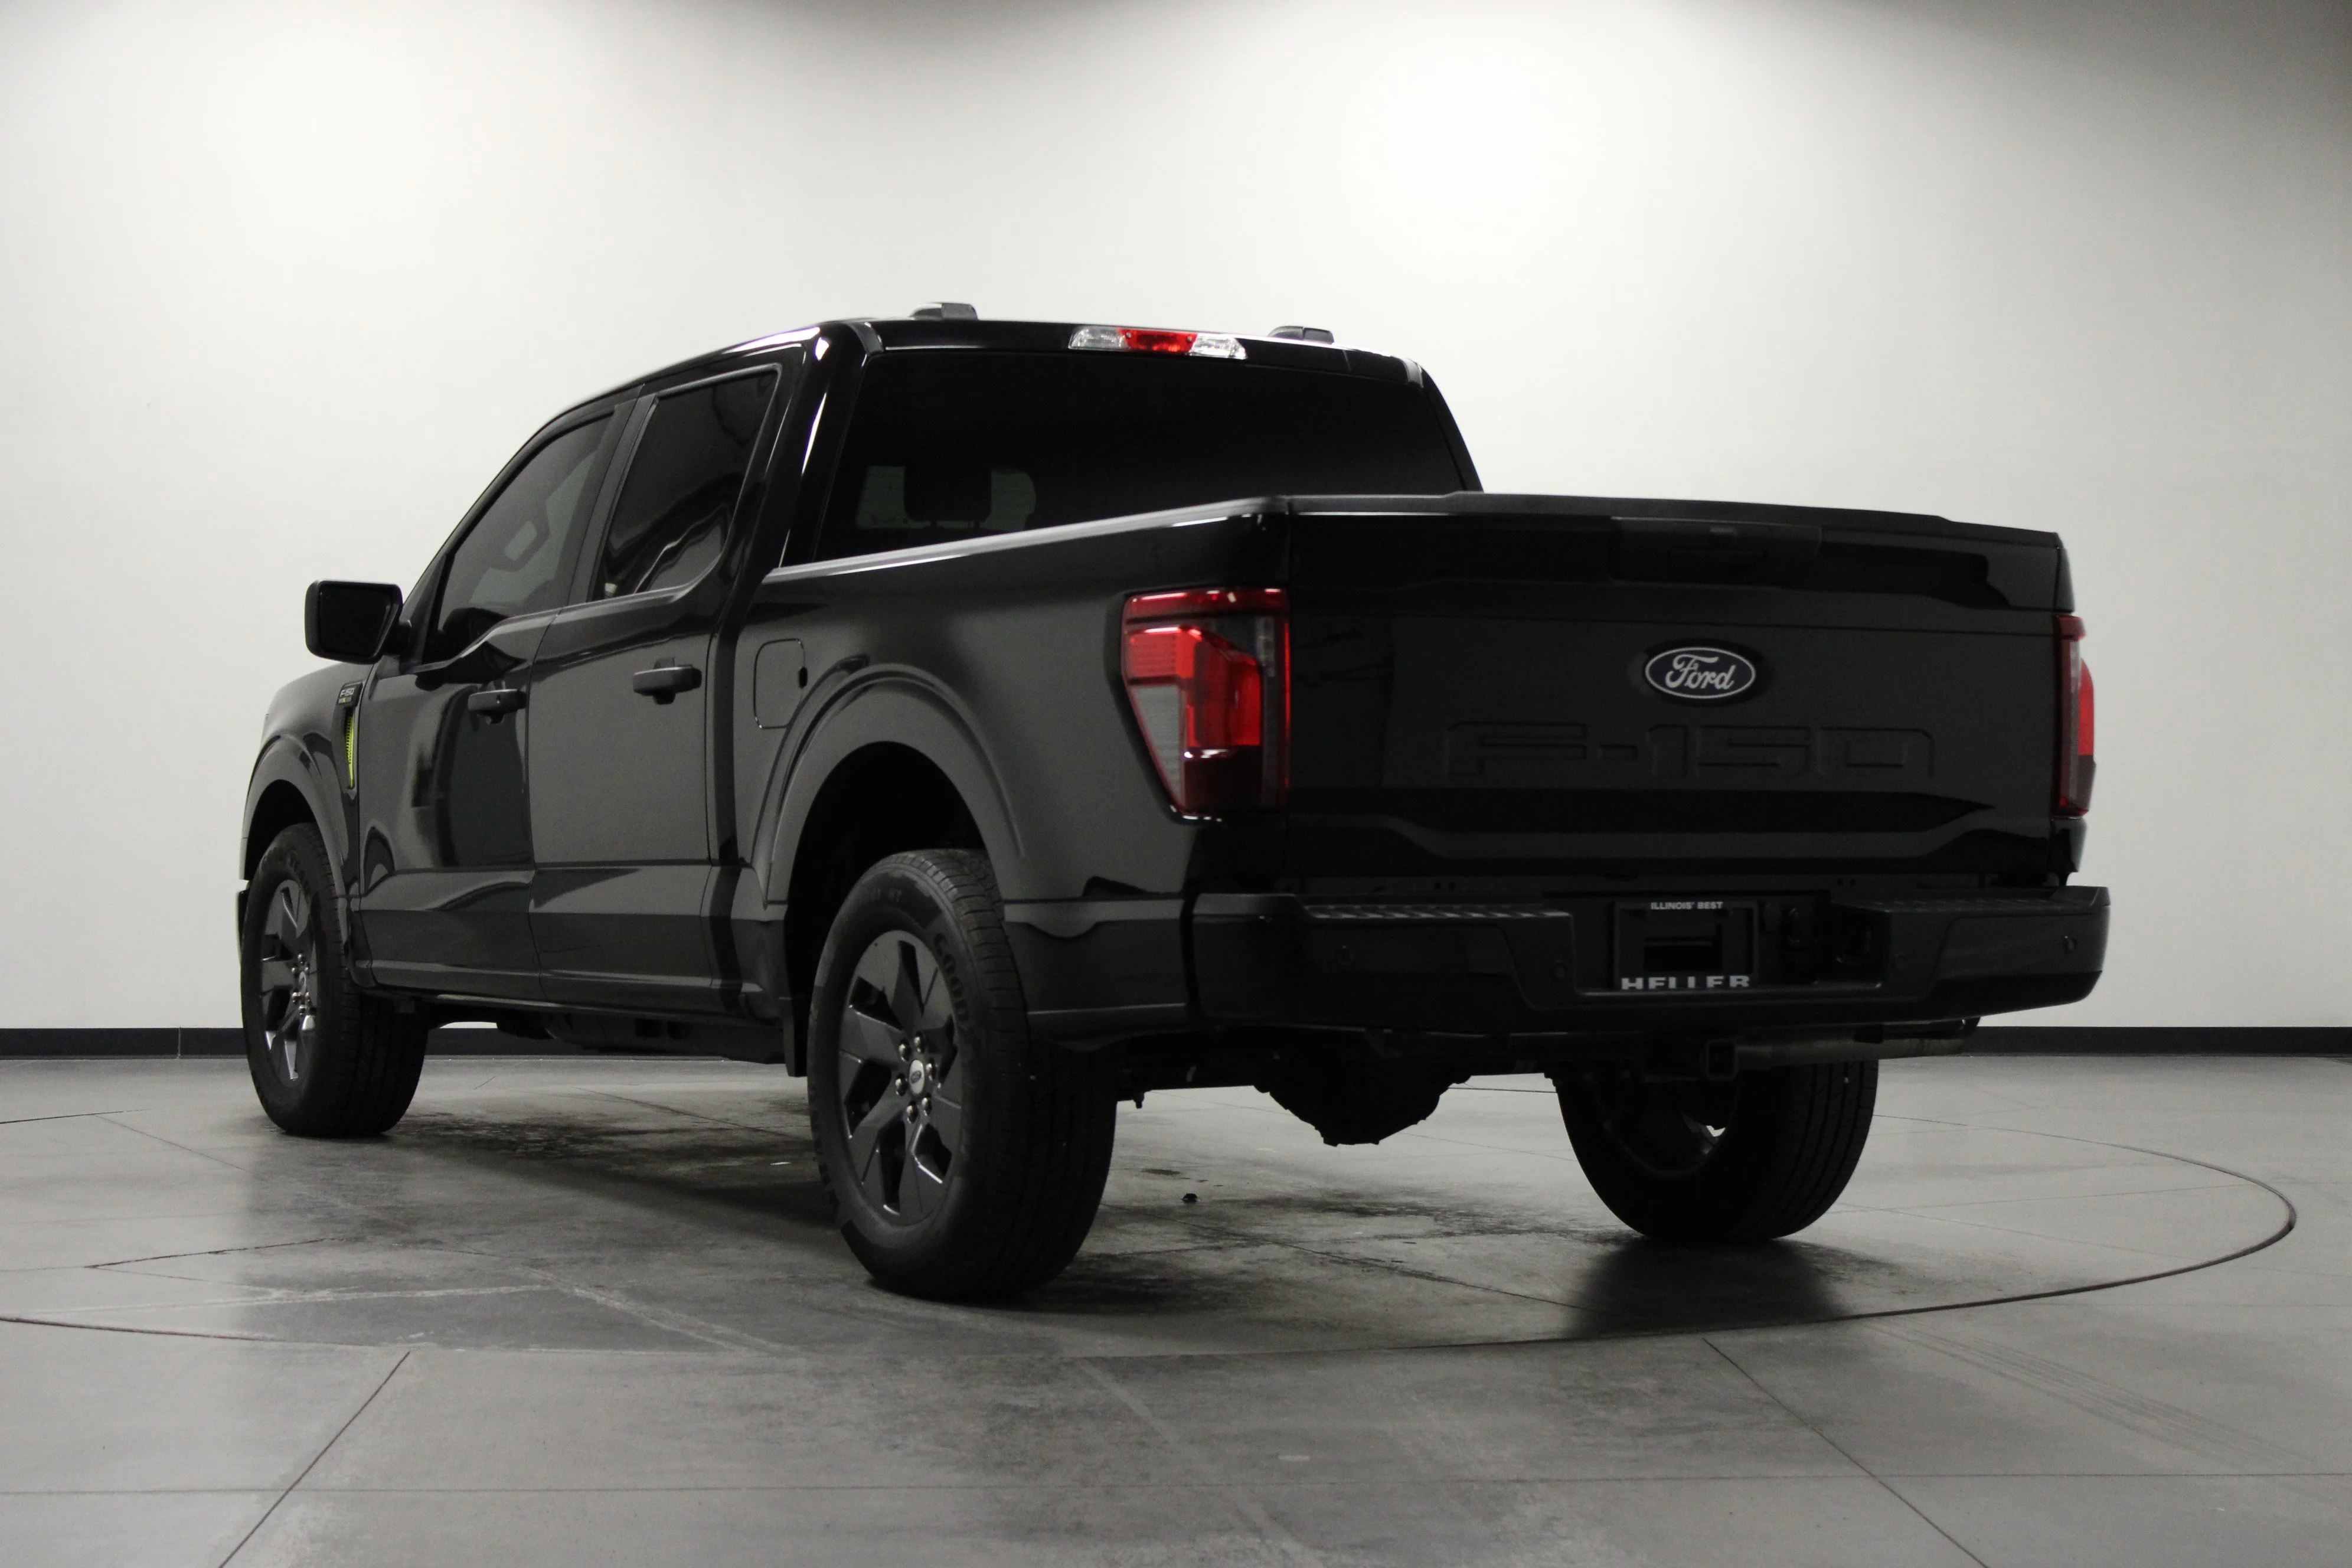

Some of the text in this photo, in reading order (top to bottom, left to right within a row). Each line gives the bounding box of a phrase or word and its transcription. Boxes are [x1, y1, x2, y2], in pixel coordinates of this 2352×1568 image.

[1665, 654, 1736, 690] Ford
[1446, 721, 1935, 780] F-150
[1697, 901, 1724, 909] BEST
